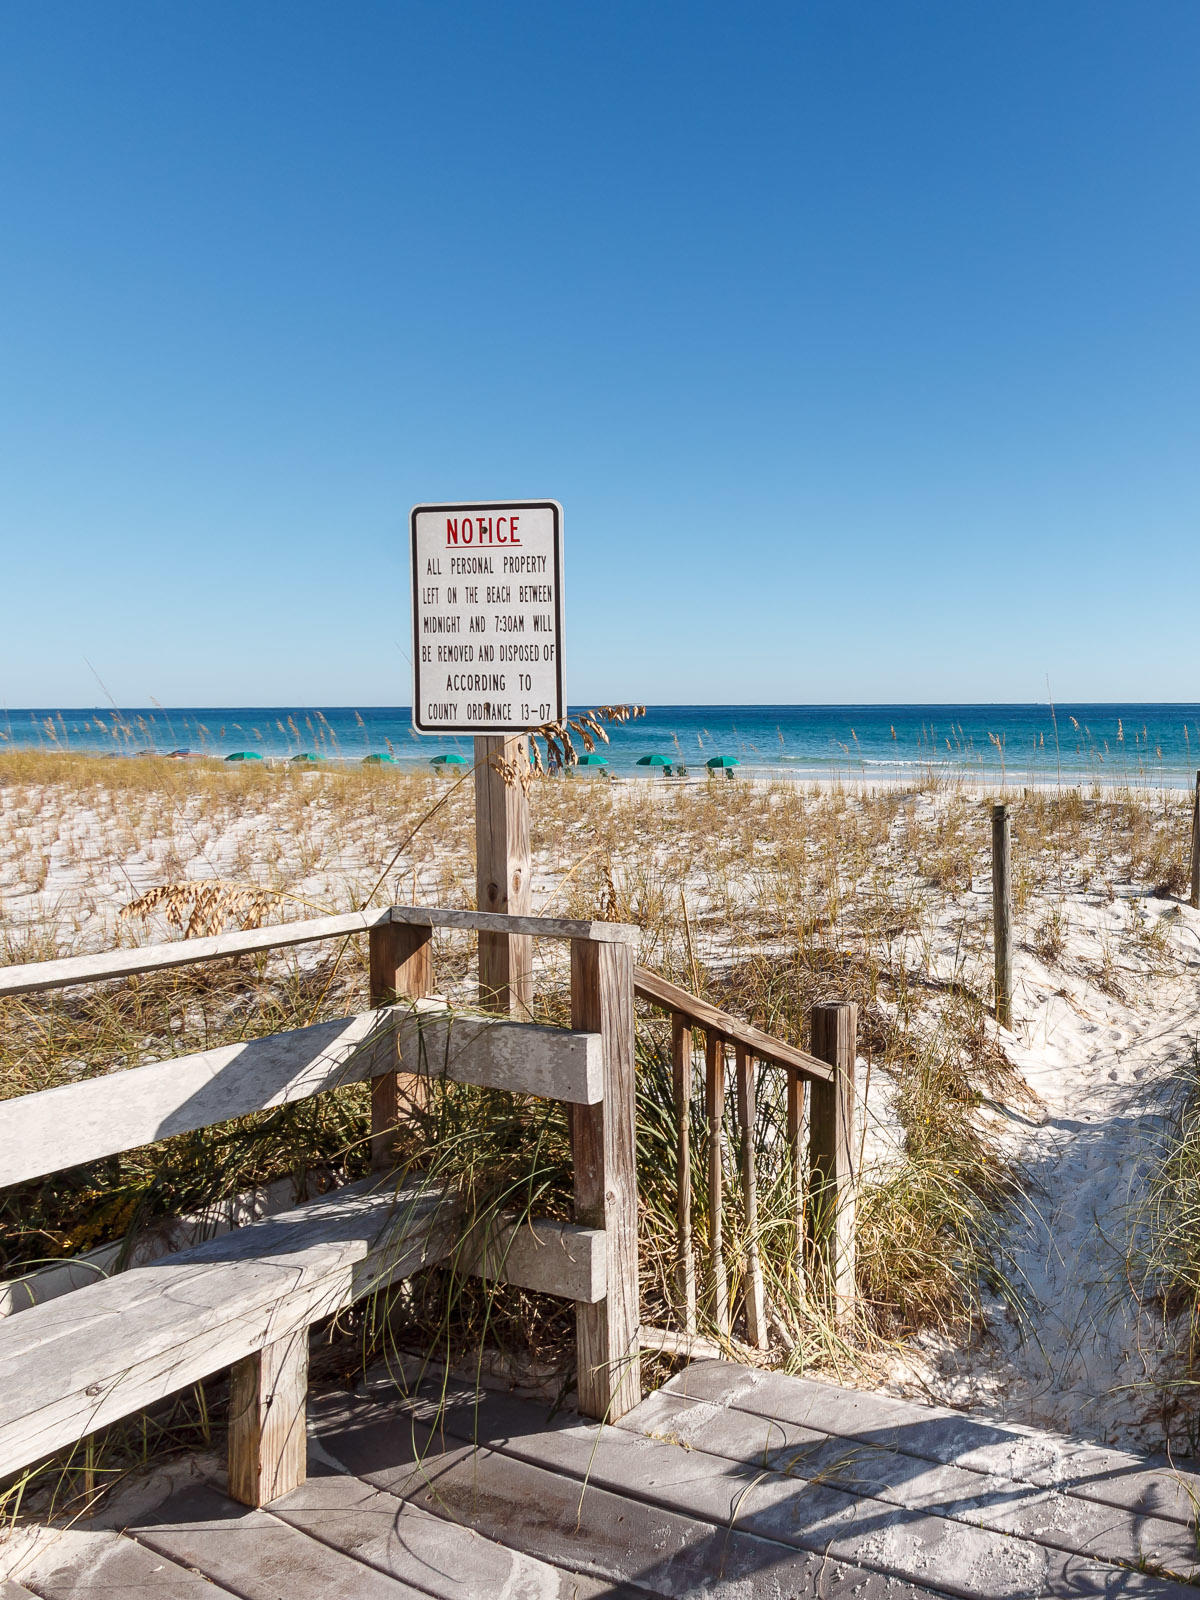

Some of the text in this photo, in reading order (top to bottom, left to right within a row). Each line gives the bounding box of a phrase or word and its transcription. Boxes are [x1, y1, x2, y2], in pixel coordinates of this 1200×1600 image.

[447, 517, 520, 544] NOTICE
[427, 556, 546, 575] ALL PERSONAL PROPERTY
[423, 585, 552, 604] LEFT ON THE BEACH BETWEEN
[424, 615, 552, 633] MIDNIGHT AND 7:30AM WILL
[423, 645, 554, 662] BE REMOVED AND DISPOSED OF
[446, 674, 531, 691] ACCORDING TO
[429, 704, 457, 720] COUNTY
